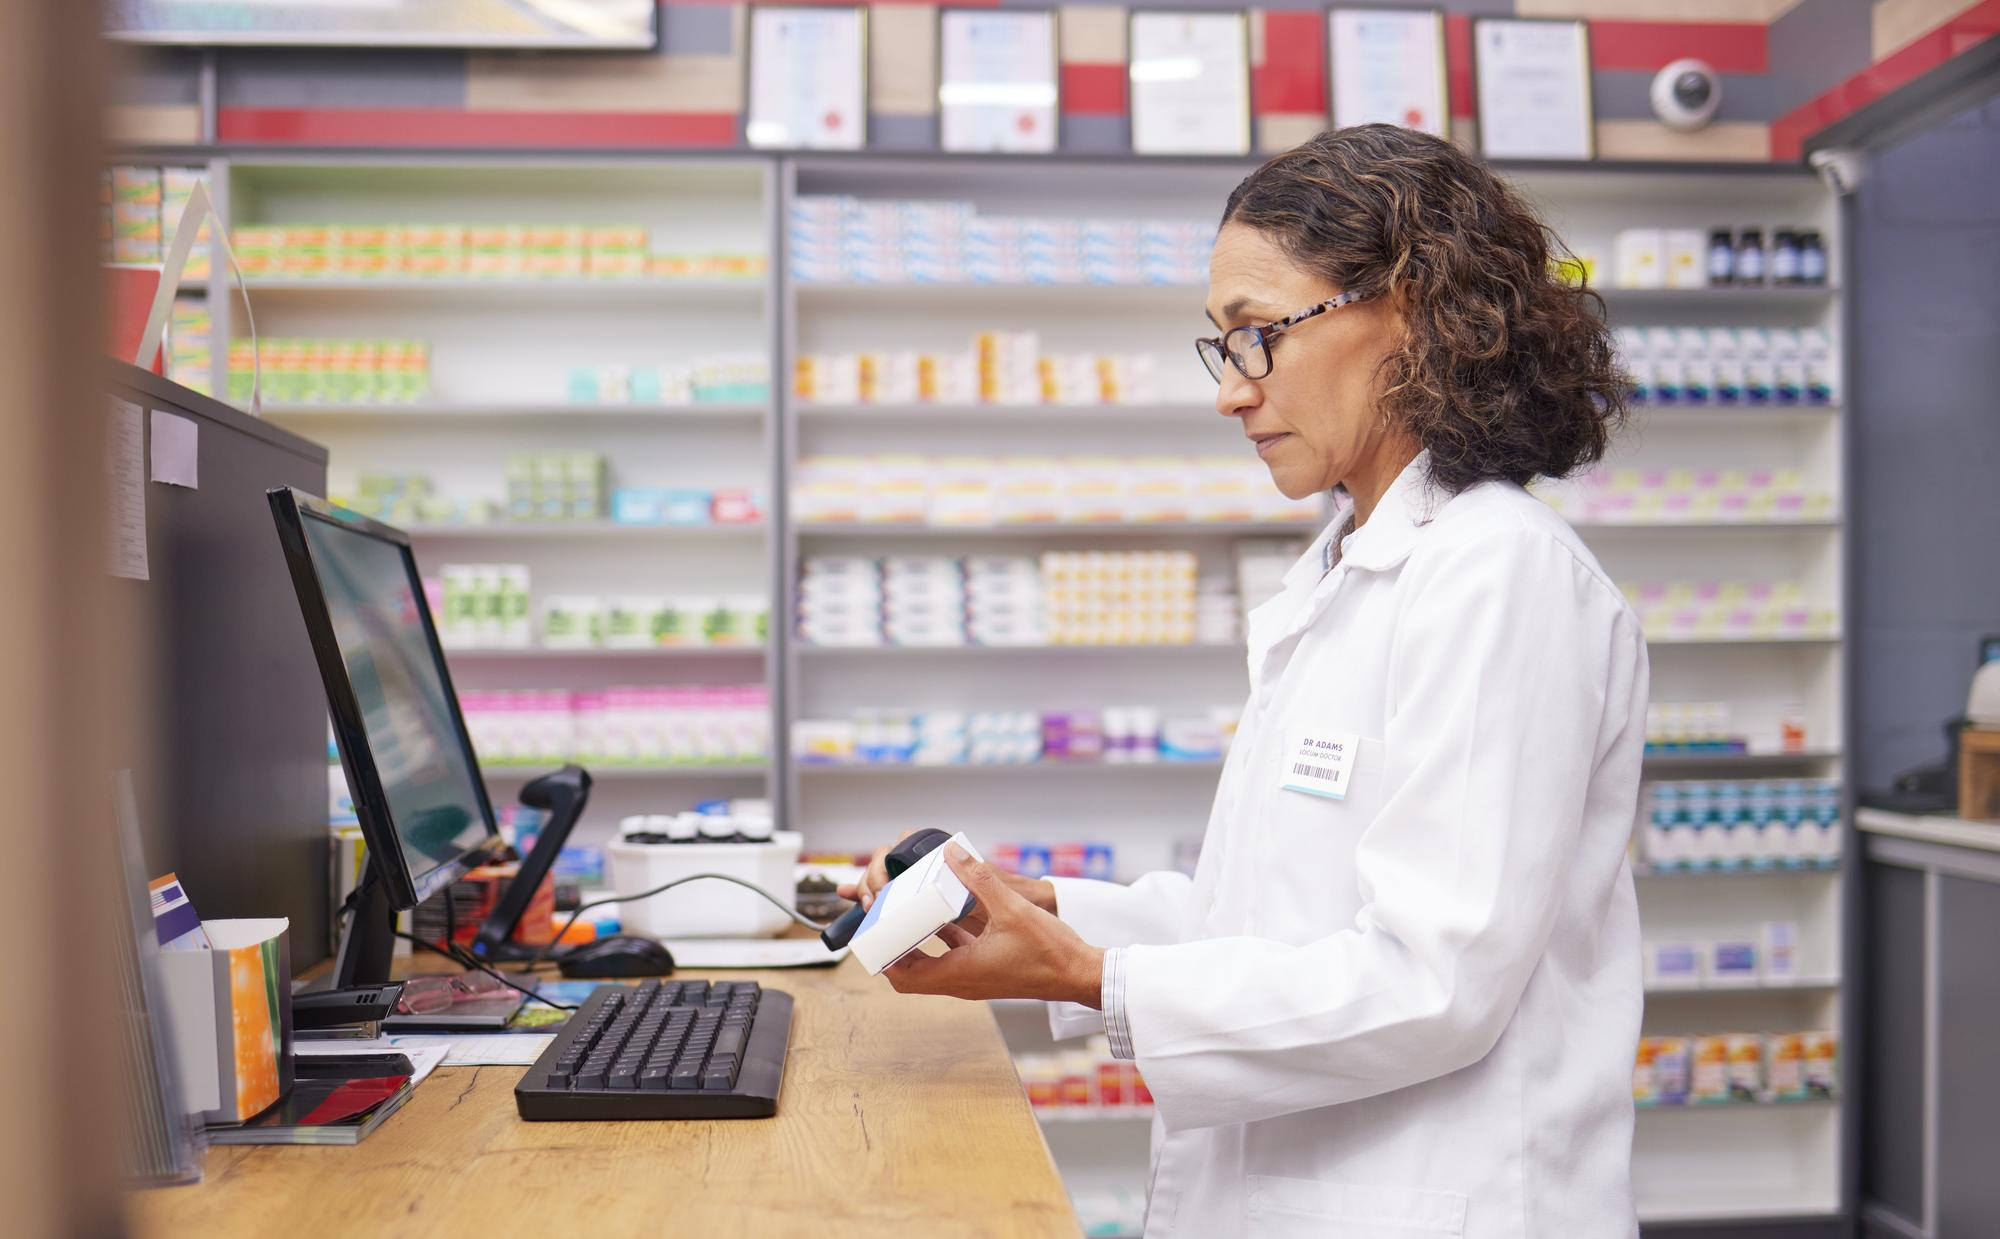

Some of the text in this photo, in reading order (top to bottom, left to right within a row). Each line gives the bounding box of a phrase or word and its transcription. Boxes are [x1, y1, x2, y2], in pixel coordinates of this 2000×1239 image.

[1303, 738, 1343, 752] DR ADAMS
[1319, 752, 1342, 761] DOCTOR
